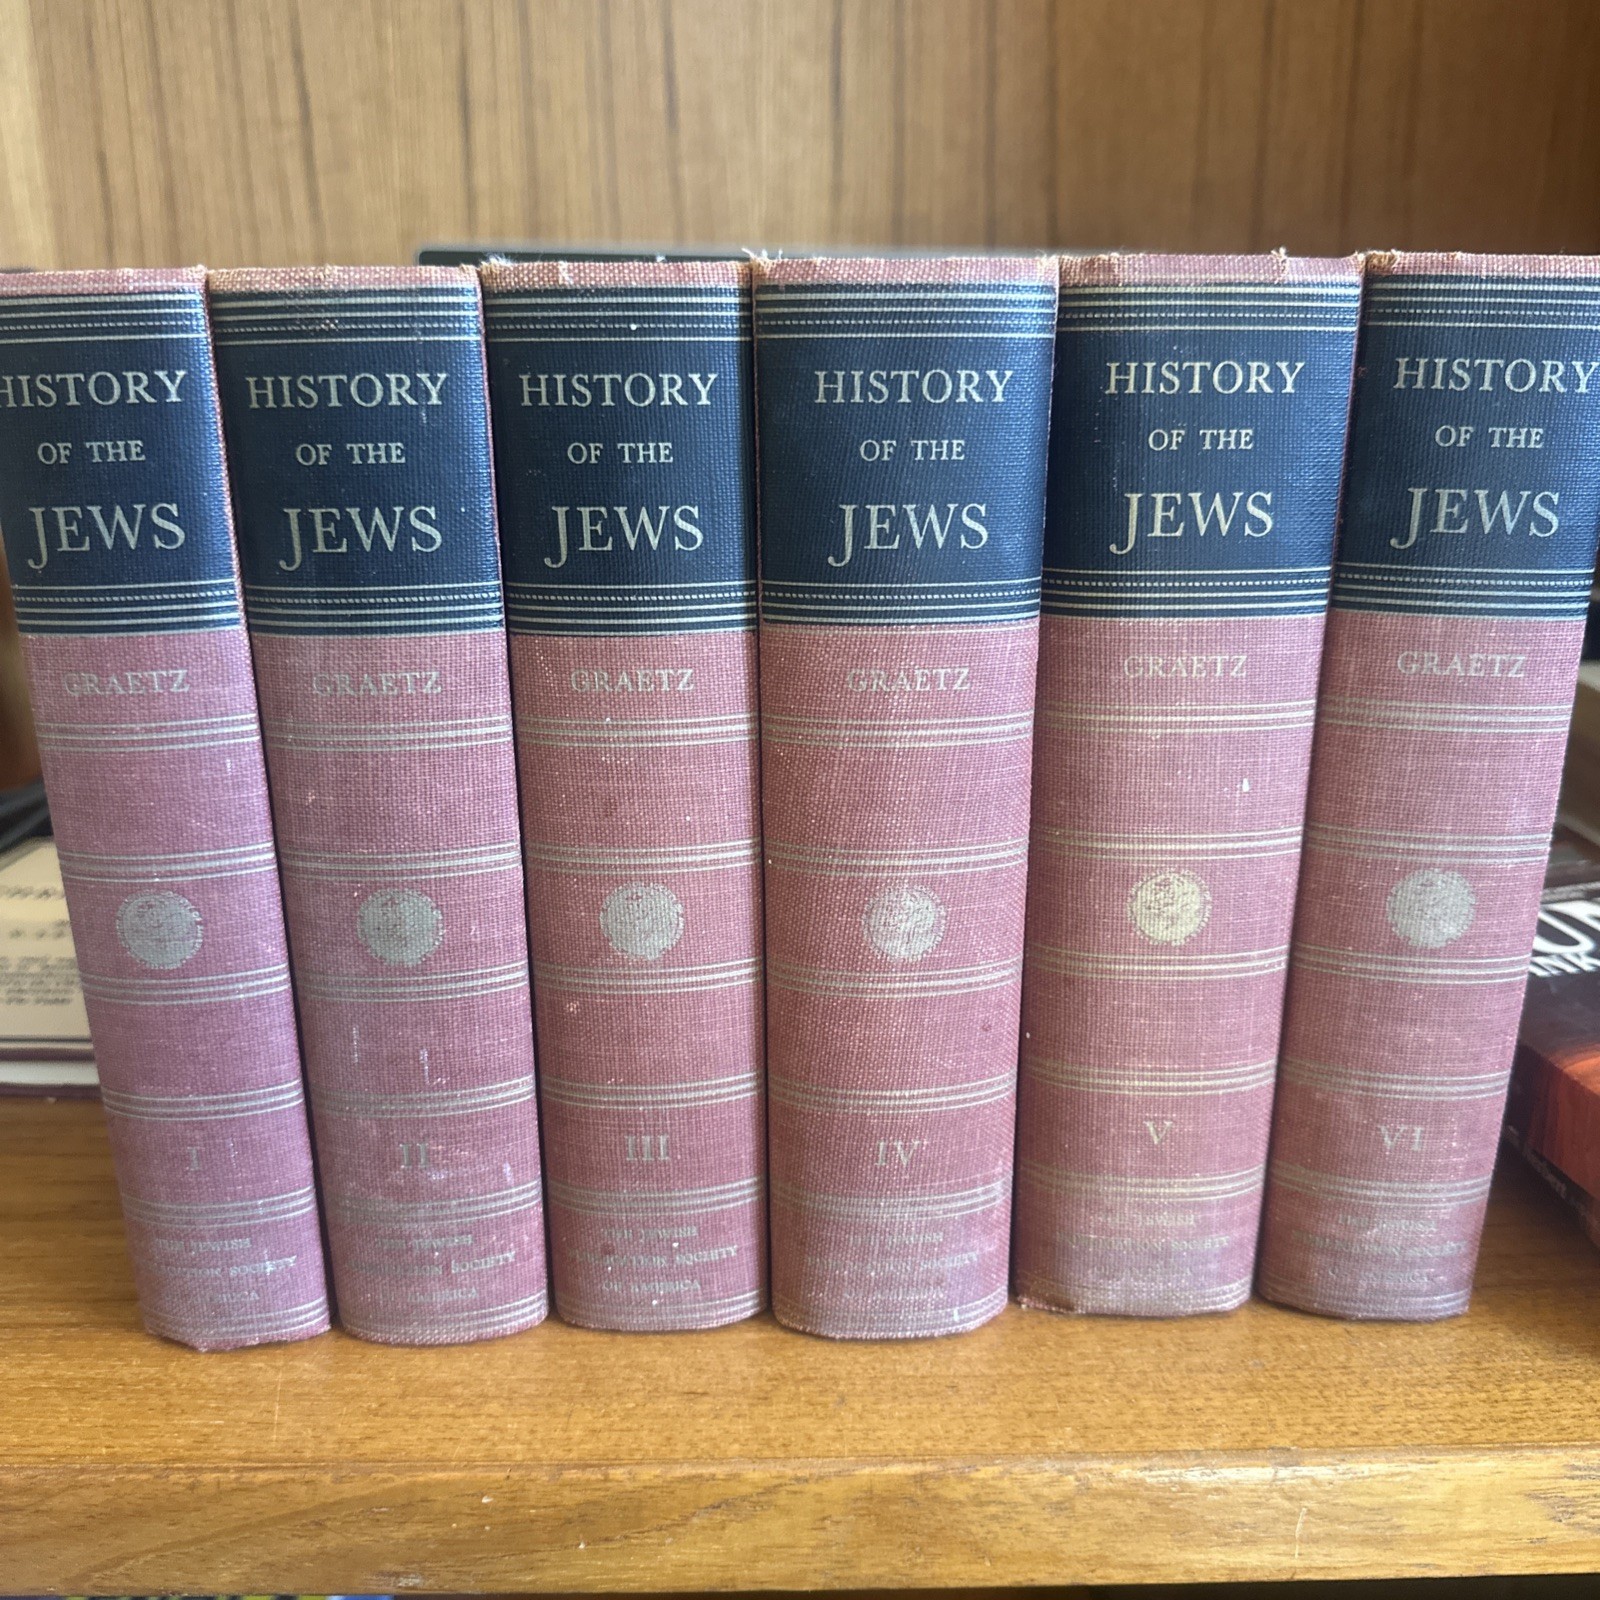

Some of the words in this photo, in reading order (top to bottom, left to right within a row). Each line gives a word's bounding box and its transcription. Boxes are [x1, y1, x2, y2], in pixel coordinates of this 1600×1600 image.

[814, 369, 1014, 404] HISTORY
[1105, 360, 1306, 395] HISTORY
[1393, 357, 1600, 393] HISTORY
[0, 371, 188, 408] HISTORY
[246, 373, 450, 409] HISTORY
[519, 372, 719, 408] HISTORY
[1148, 429, 1186, 451] OF
[1199, 429, 1254, 450] THE
[1434, 424, 1475, 448] OF
[1488, 427, 1545, 449] THE
[37, 442, 73, 465] OF
[85, 440, 147, 463] THE
[295, 443, 333, 466] OF
[346, 442, 406, 465] THE
[567, 442, 604, 465] OF
[617, 442, 674, 464] THE
[859, 439, 897, 462] OF
[910, 439, 966, 461] THE
[1109, 491, 1274, 555] JEWS
[1389, 487, 1560, 550] JEWS
[27, 502, 186, 570] JEWS
[279, 505, 443, 572] JEWS
[544, 505, 705, 569] JEWS
[827, 503, 989, 568] JEWS
[1123, 654, 1249, 678] GRAETZ
[1396, 650, 1526, 677] GRAETZ
[63, 669, 190, 695] GRAETZ
[312, 670, 442, 695] GRAETZ
[570, 668, 695, 692] GRAETZ
[847, 667, 971, 692] GRAETZ
[1143, 1119, 1174, 1145] V
[1378, 1122, 1426, 1152] VI
[185, 1145, 202, 1171] I
[399, 1142, 430, 1169] II
[625, 1133, 671, 1161] III
[876, 1139, 922, 1168] IV
[190, 1237, 252, 1252] JEWISH
[229, 1254, 297, 1278] SOCIETY
[451, 1250, 516, 1274] SOCIETY
